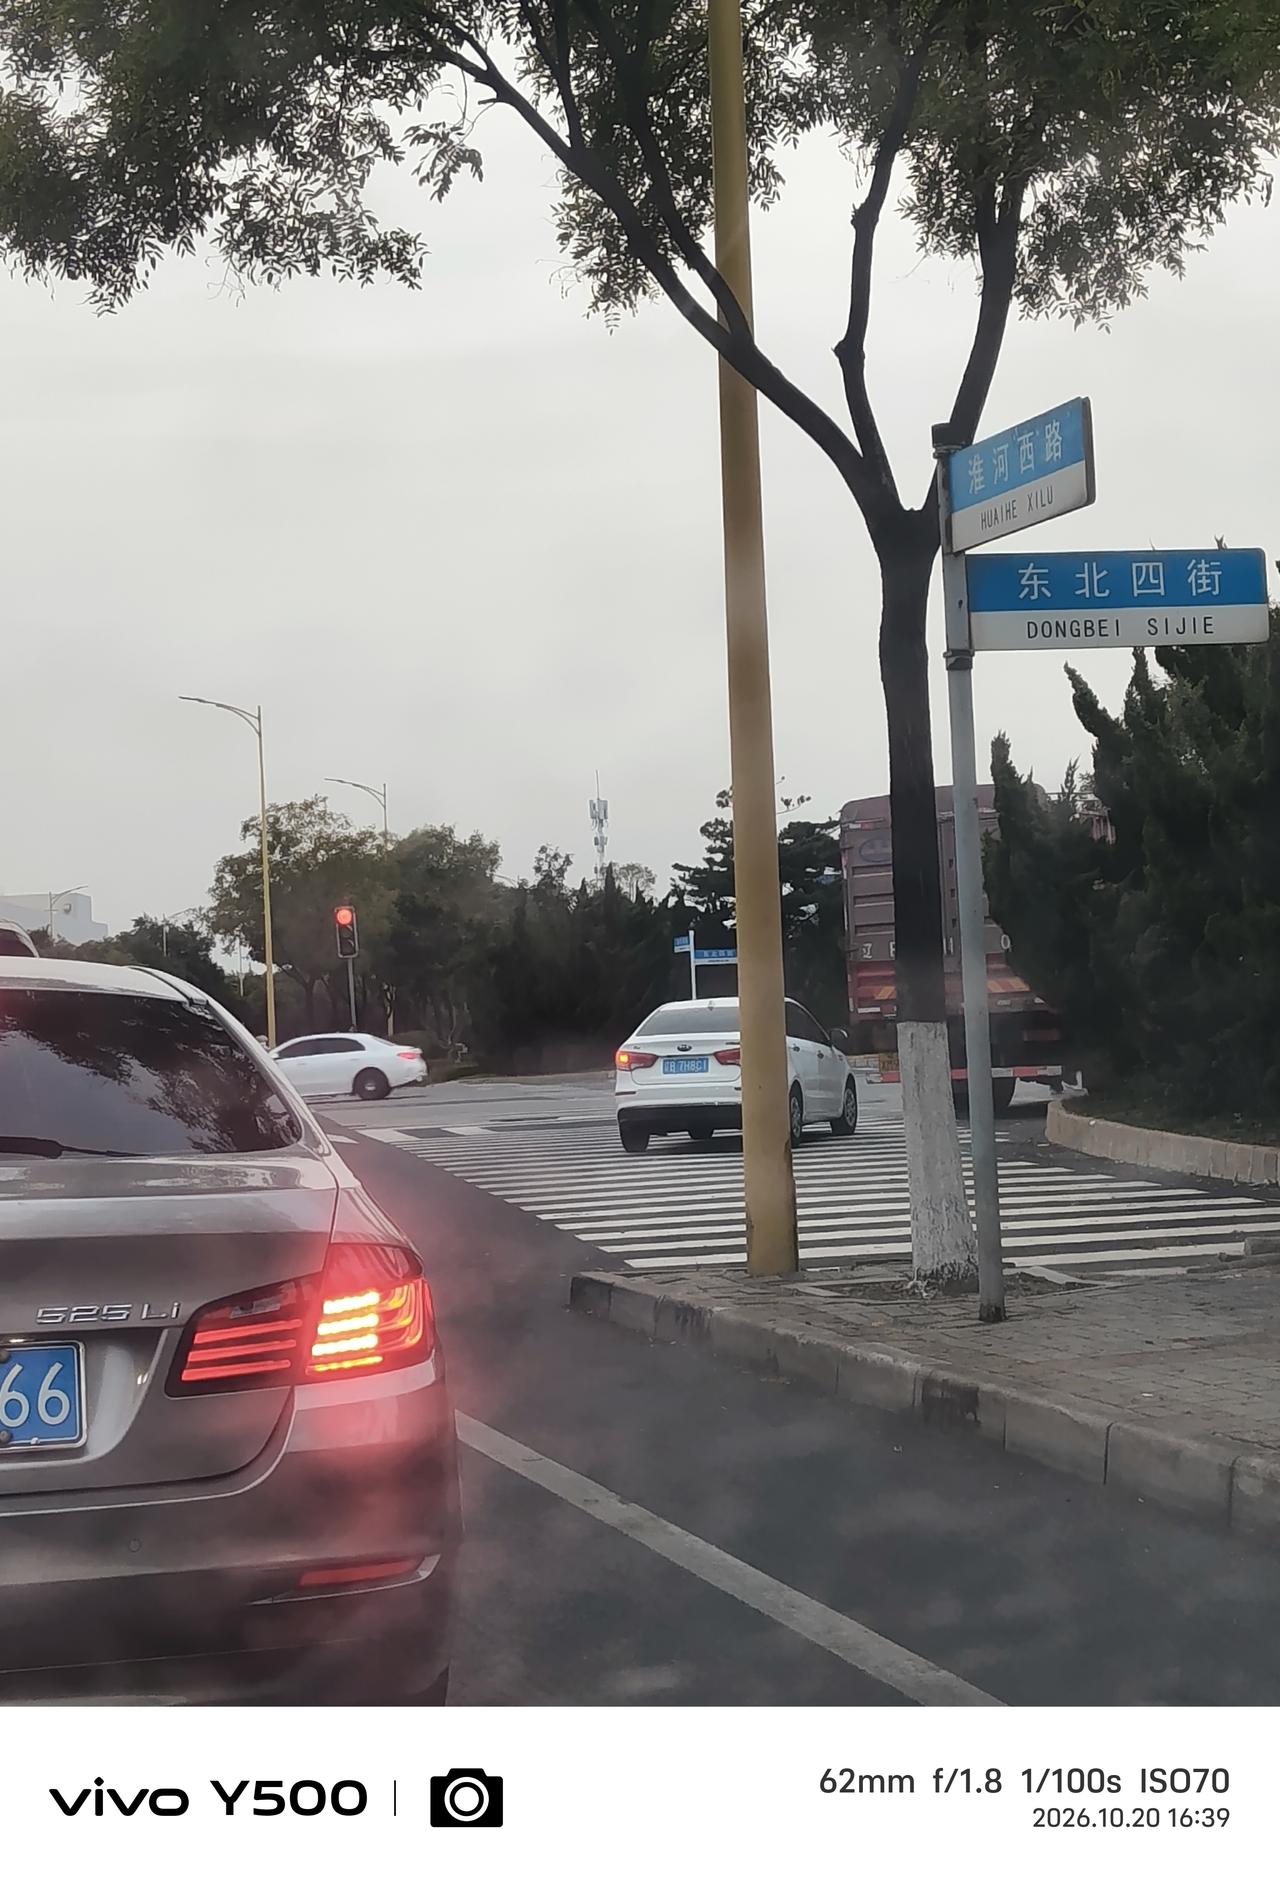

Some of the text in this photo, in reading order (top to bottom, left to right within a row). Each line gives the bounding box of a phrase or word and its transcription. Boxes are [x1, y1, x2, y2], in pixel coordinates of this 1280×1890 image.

[968, 419, 1064, 495] 淮河西路
[980, 485, 1055, 531] HUAIHE XILU
[1017, 559, 1223, 601] 东北四街
[1026, 616, 1215, 639] DONGBEI SIJIE
[36, 1302, 181, 1324] 525 Li
